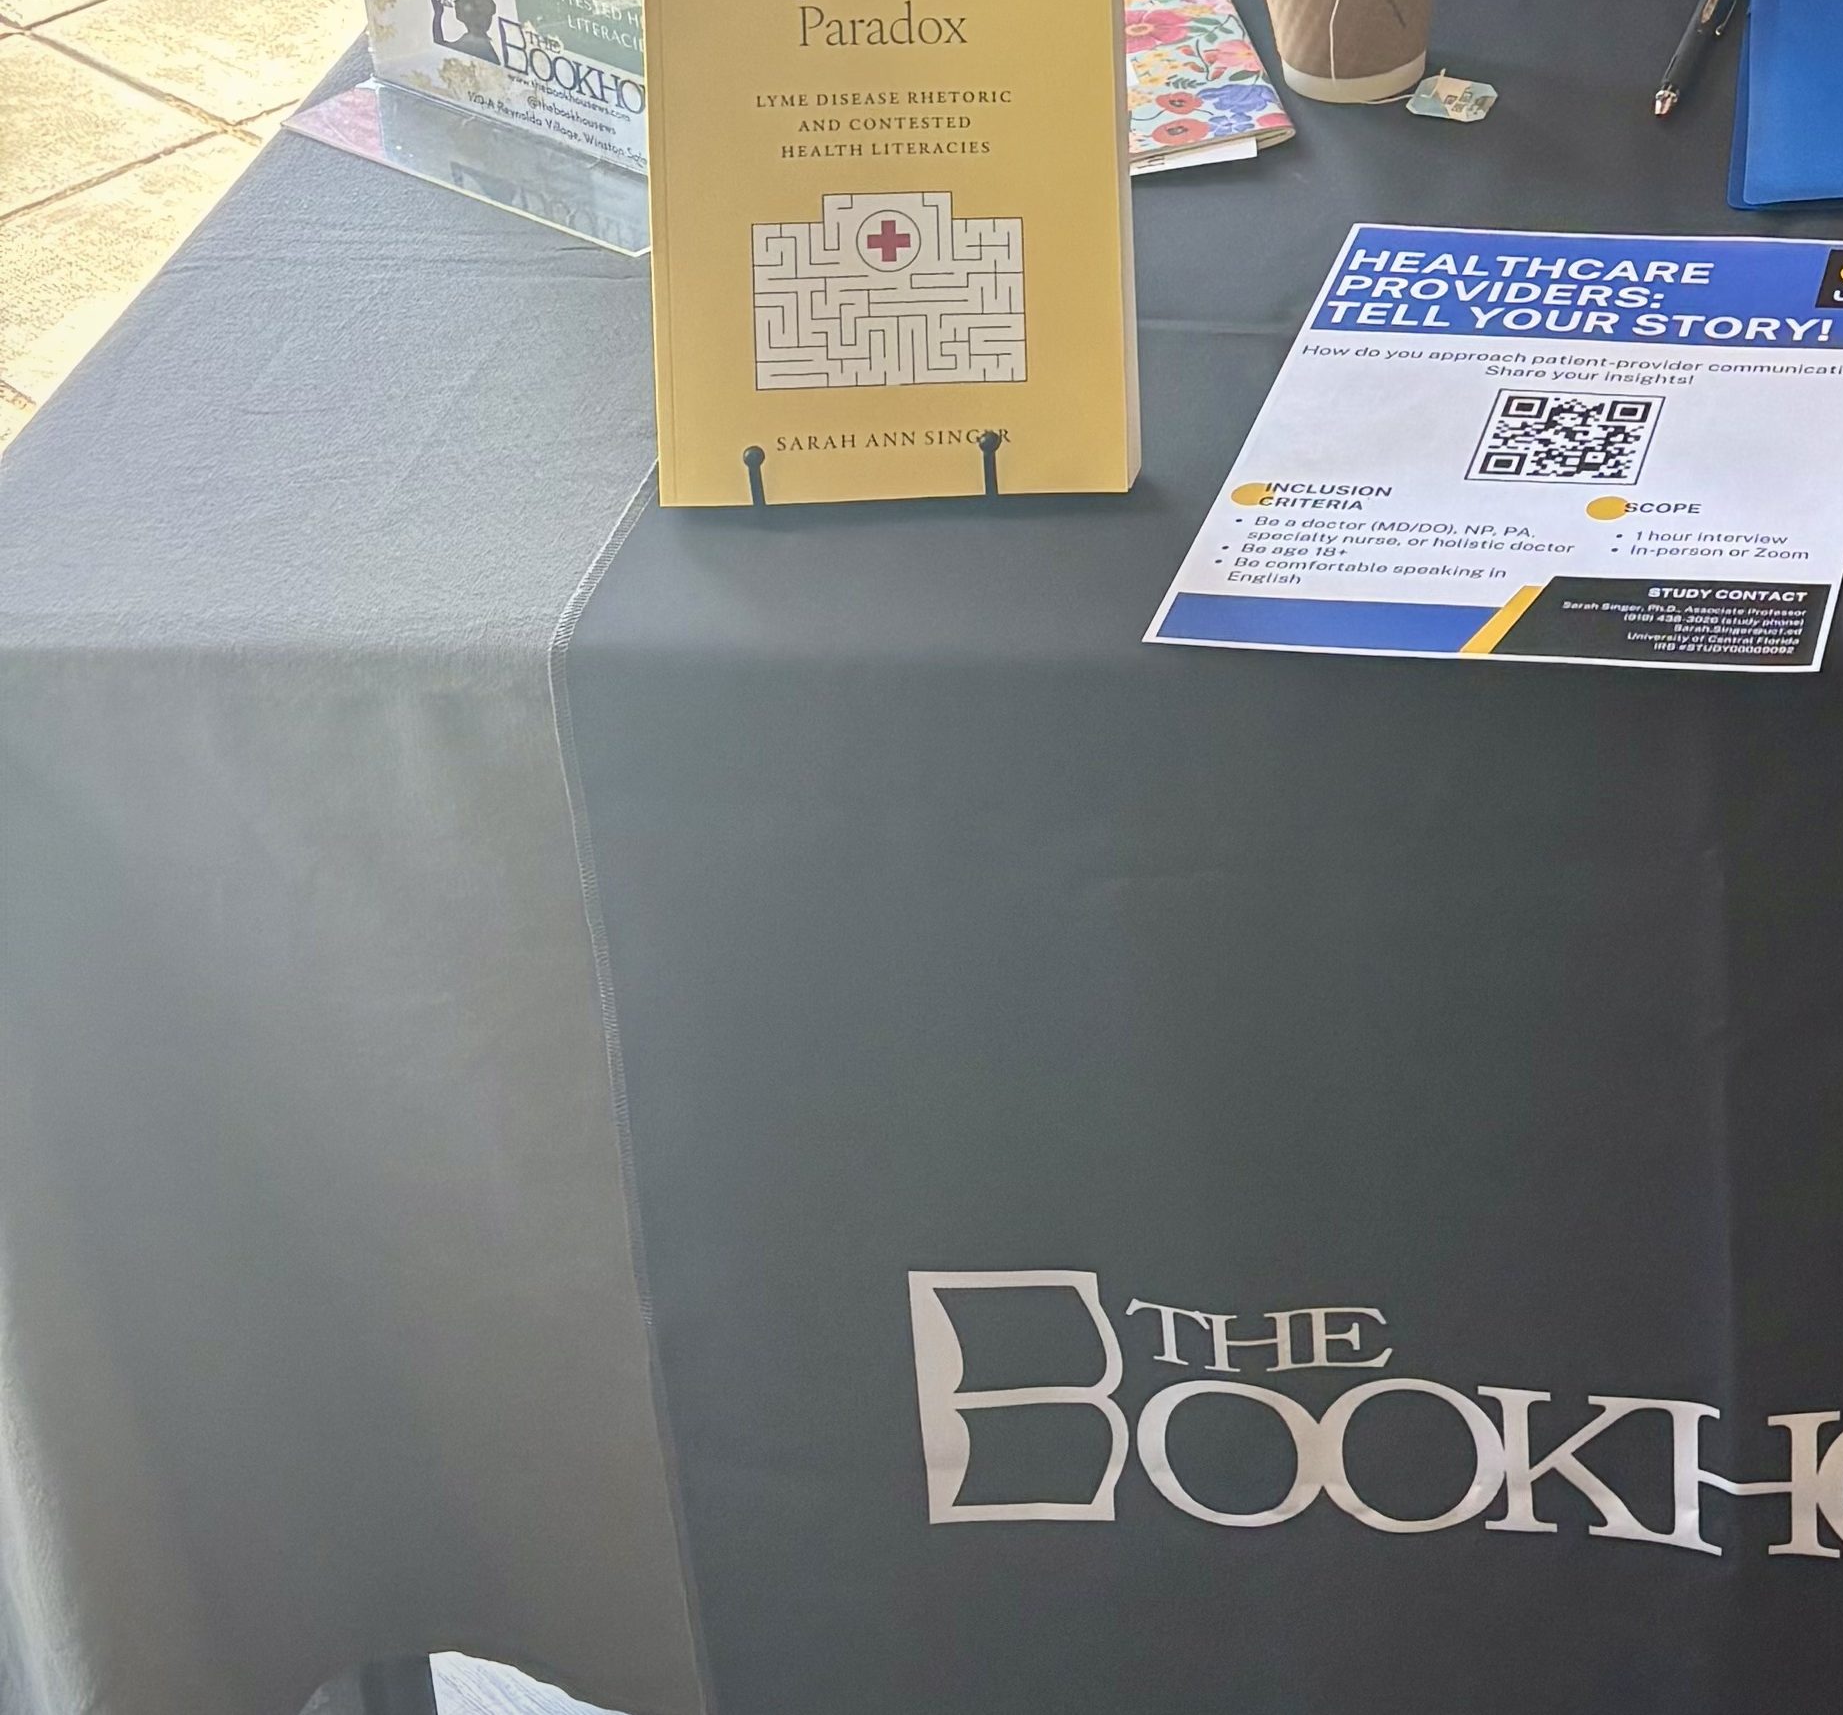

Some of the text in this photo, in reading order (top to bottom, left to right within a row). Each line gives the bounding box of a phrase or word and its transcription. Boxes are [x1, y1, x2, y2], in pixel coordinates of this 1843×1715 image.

[797, 2, 969, 49] Paradox
[756, 90, 1012, 108] LYME DISEASE RHETORIC
[798, 114, 971, 132] AND CONTESTED
[781, 139, 990, 159] HEALTH LITERACIES
[1347, 249, 1714, 284] HEALTHCARE
[1335, 274, 1665, 310] PROVIDERS:
[1326, 301, 1833, 343] TELL YOUR STORY!
[777, 429, 1011, 451] SARAH ANN SINGR
[1264, 482, 1392, 497] INCLUSION
[1258, 497, 1365, 511] CRITERIA
[1624, 501, 1702, 515] SCOPE
[1647, 588, 1807, 603] STUDY CONTACT
[1125, 1297, 1394, 1373] THE
